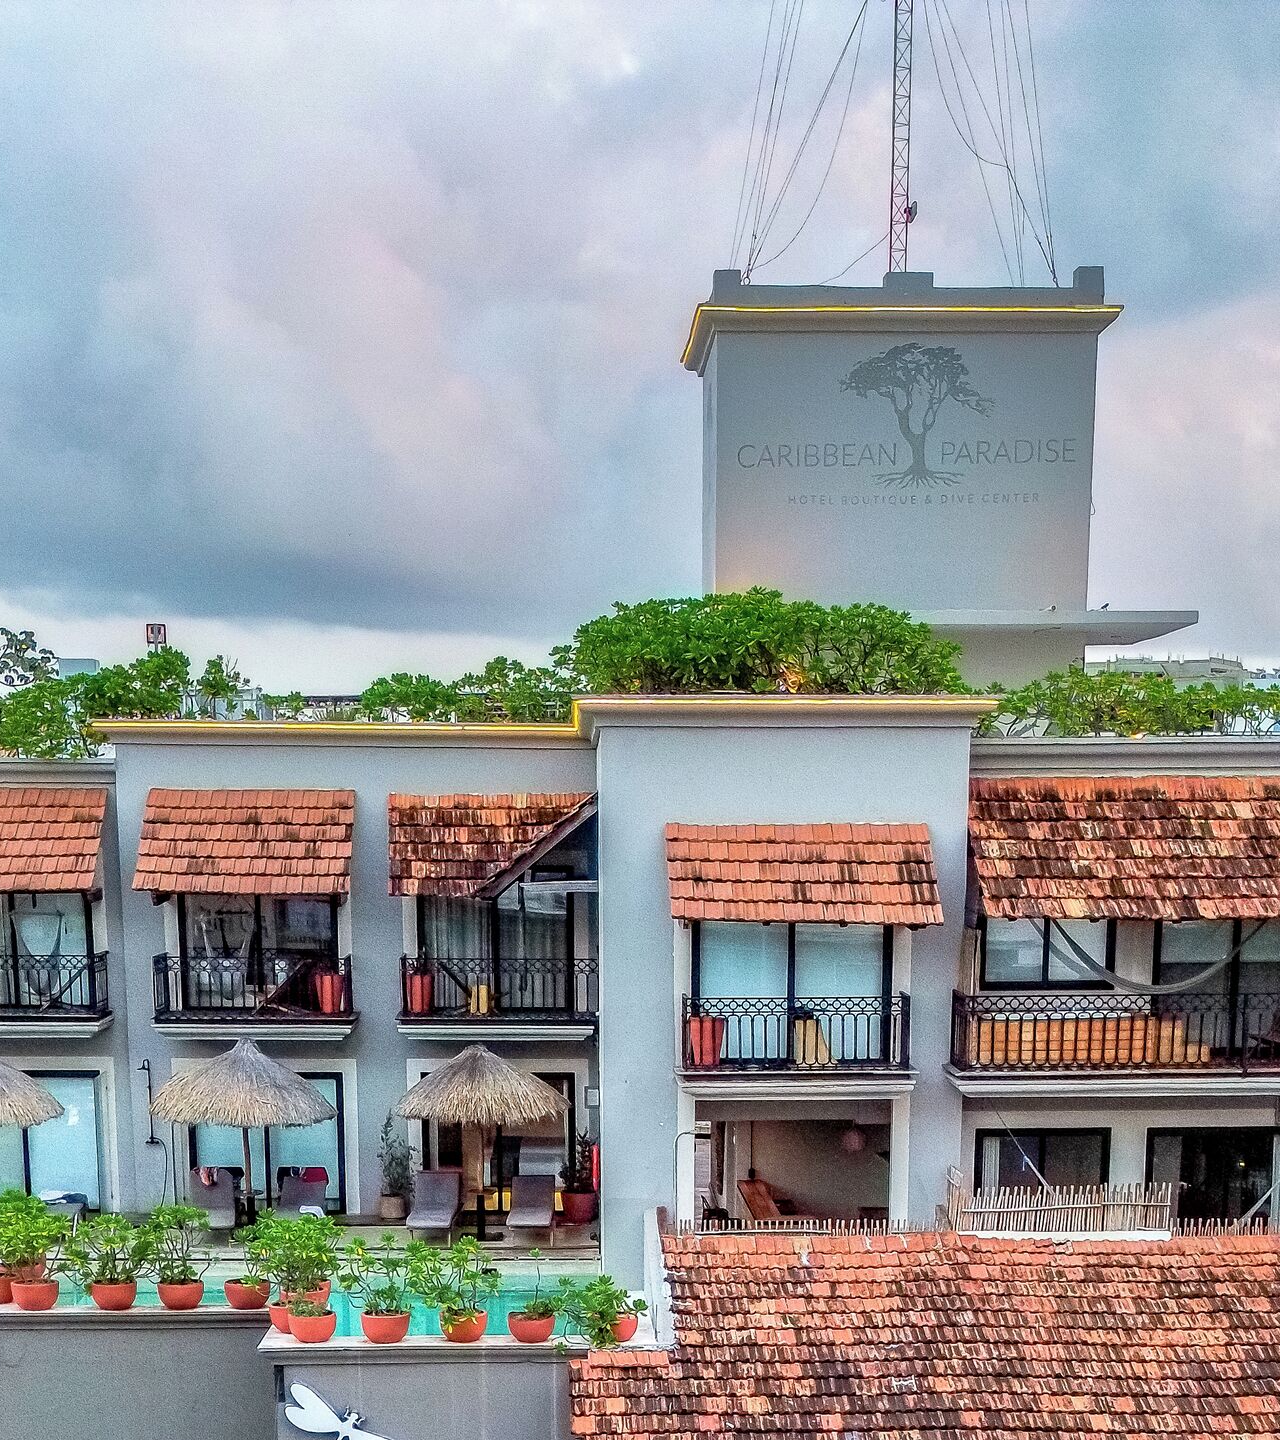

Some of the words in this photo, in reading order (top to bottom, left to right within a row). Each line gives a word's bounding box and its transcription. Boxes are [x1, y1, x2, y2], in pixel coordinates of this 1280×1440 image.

[737, 442, 898, 469] CARIBBEAN
[939, 438, 1077, 465] PARADISE
[787, 494, 833, 506] HOTEL
[841, 494, 918, 506] BOUTIQUE
[939, 493, 974, 505] DIVE
[981, 492, 1040, 504] CENTER
